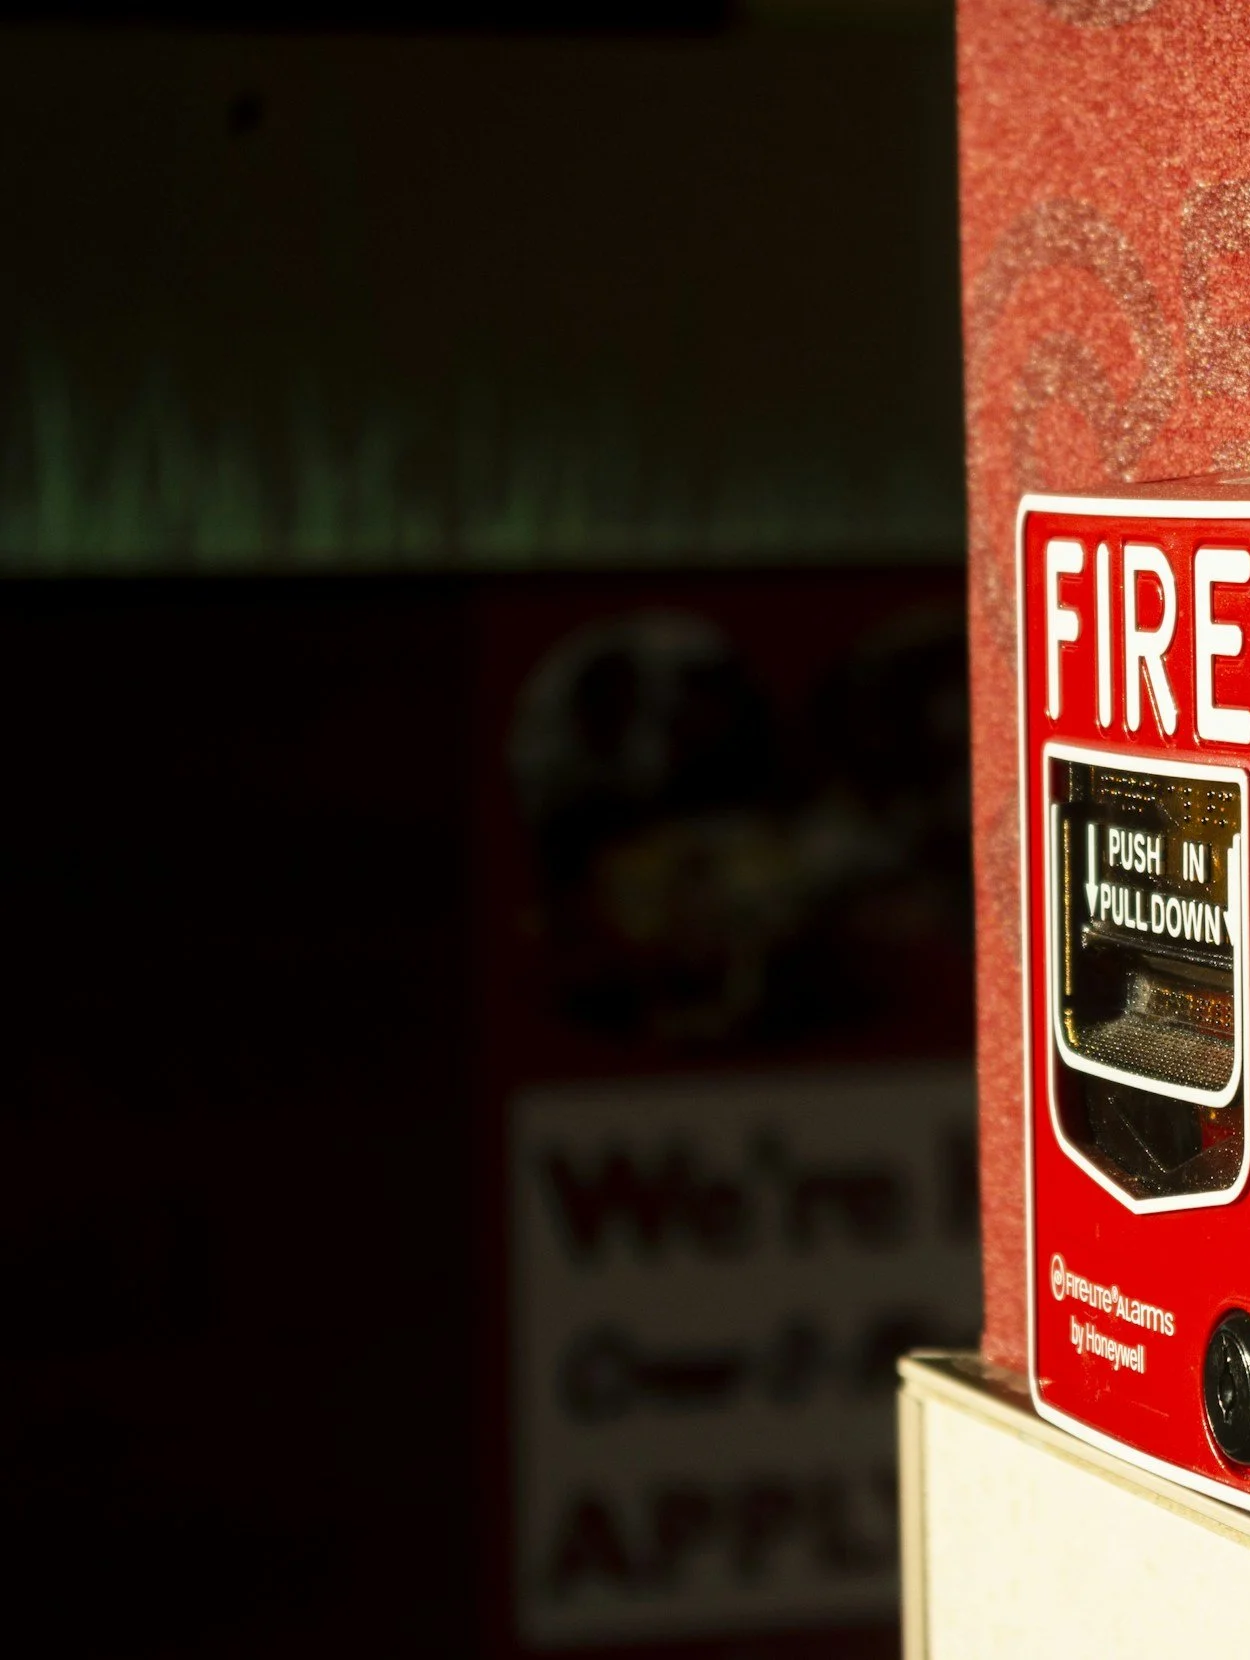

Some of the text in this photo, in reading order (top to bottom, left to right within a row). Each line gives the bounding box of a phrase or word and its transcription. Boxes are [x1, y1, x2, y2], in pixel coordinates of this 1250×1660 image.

[1109, 828, 1204, 884] PUSH IN
[1100, 882, 1221, 946] PULL DOWN
[1070, 1315, 1145, 1374] by Honeywell
